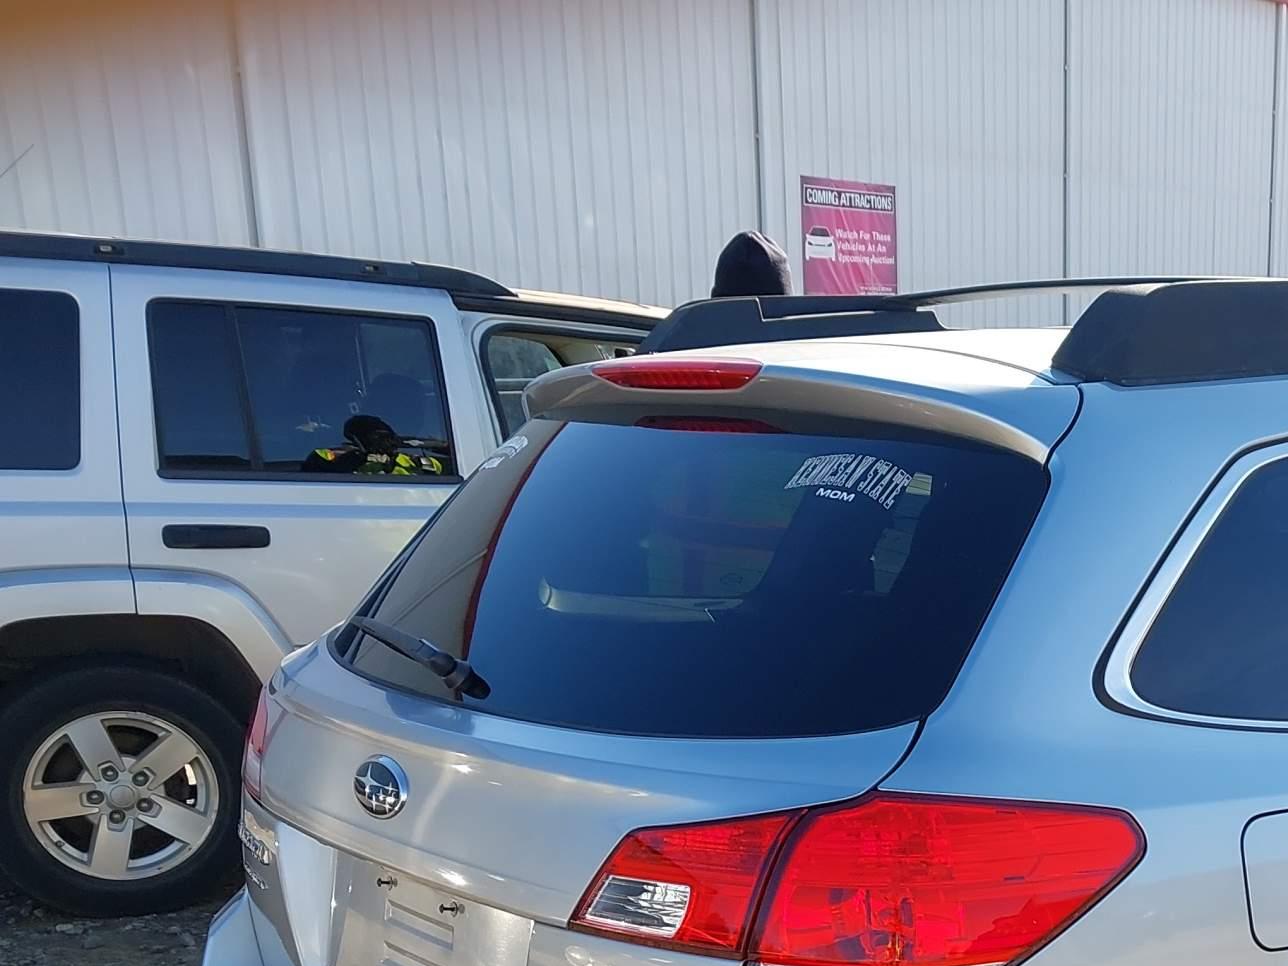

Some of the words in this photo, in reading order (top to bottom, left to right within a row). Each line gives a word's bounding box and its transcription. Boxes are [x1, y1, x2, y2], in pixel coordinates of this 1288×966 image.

[806, 188, 839, 206] COMING
[839, 192, 892, 210] ATTRACTIONS
[835, 228, 858, 239] Watch
[859, 230, 871, 240] For
[872, 231, 891, 242] These
[836, 240, 866, 252] Vehicles
[867, 242, 876, 252] At
[877, 243, 887, 253] An
[838, 252, 870, 266] Upcoming
[857, 458, 912, 510] STATE
[816, 487, 856, 502] MOM
